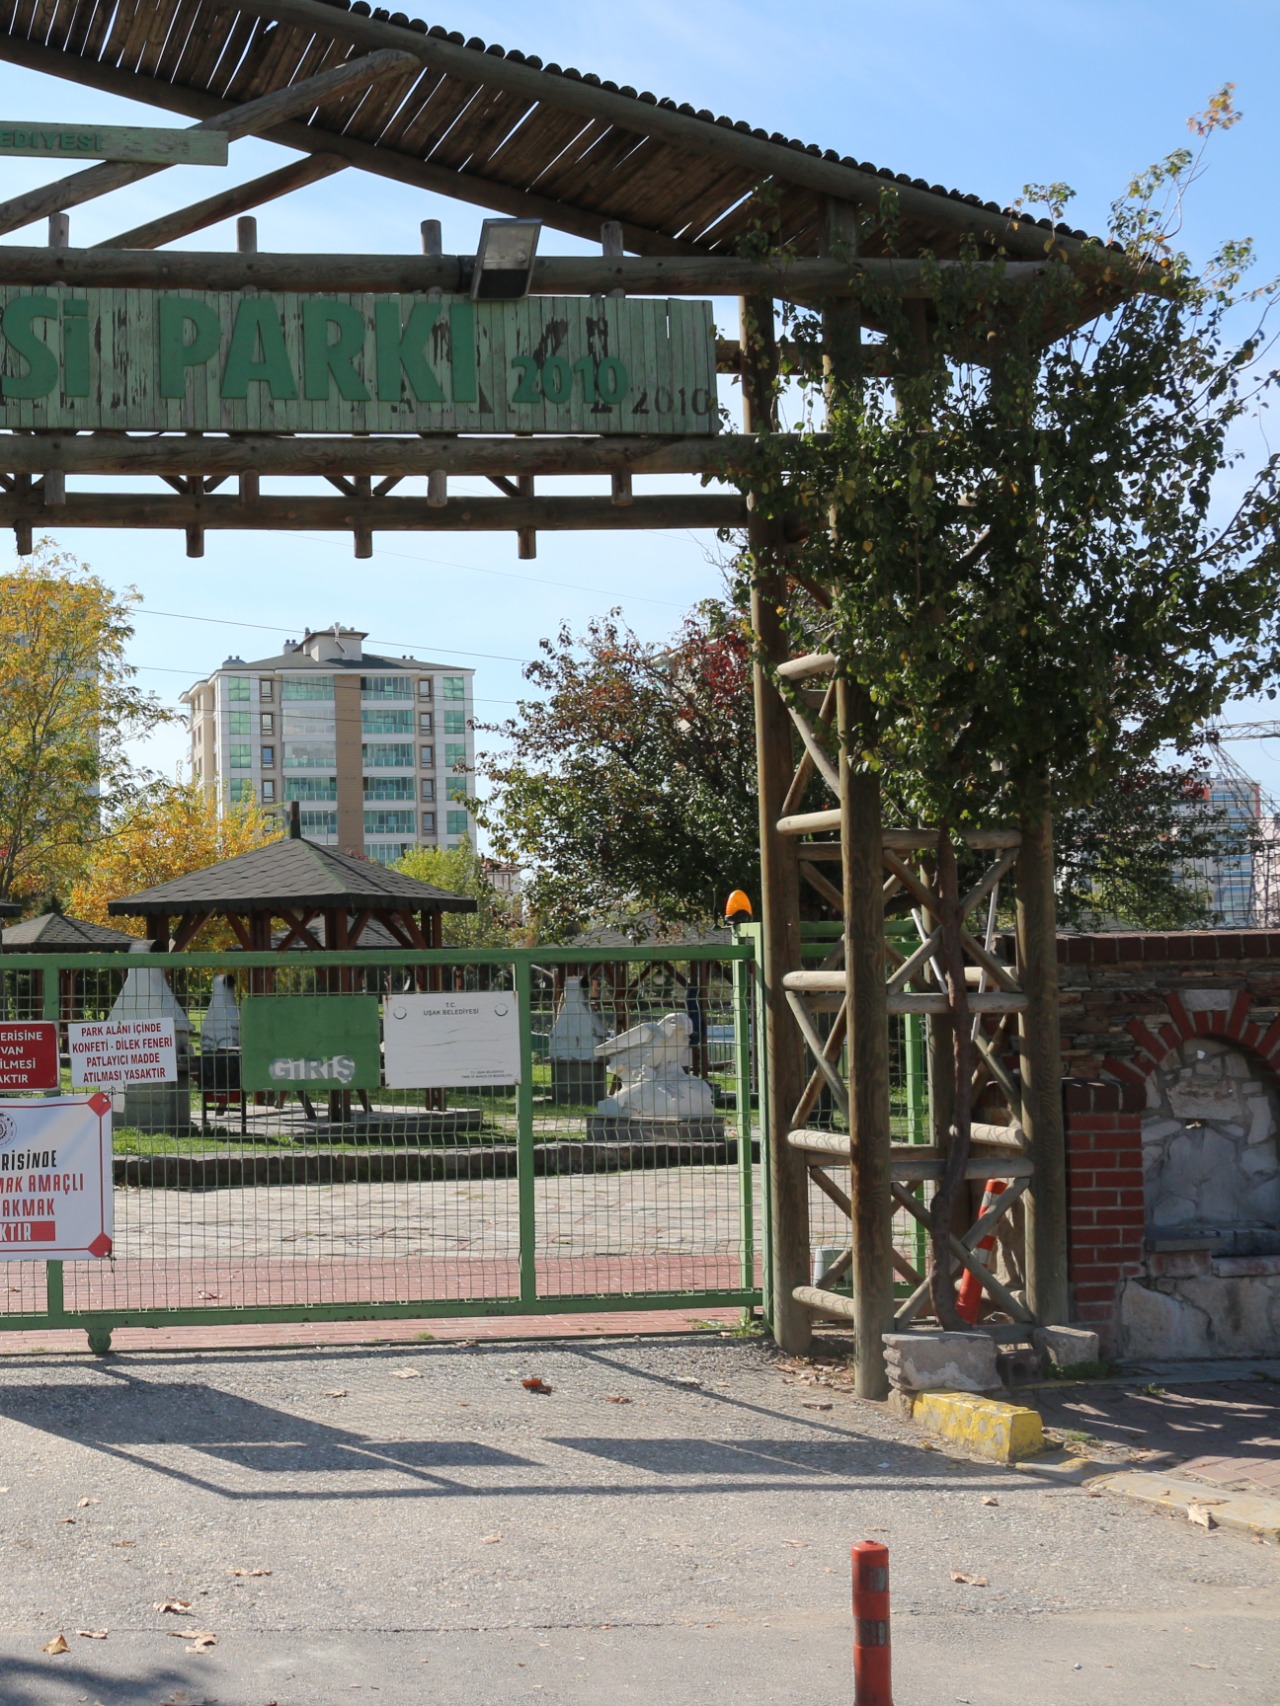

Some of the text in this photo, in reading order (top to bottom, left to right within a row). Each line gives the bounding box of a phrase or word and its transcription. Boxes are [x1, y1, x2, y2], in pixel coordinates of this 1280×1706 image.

[159, 297, 478, 404] PARKI
[510, 354, 628, 405] 2010
[81, 1026, 104, 1037] PARK
[133, 1021, 162, 1036] İÇİNDE
[72, 1039, 109, 1053] KONFETİ
[115, 1037, 141, 1051] DİLEK
[142, 1034, 173, 1048] FENERİ
[86, 1052, 160, 1067] PATLAYICI MADDE
[83, 1067, 166, 1083] ATILMASI YASAKTIR
[28, 1173, 84, 1195] AMAÇLI
